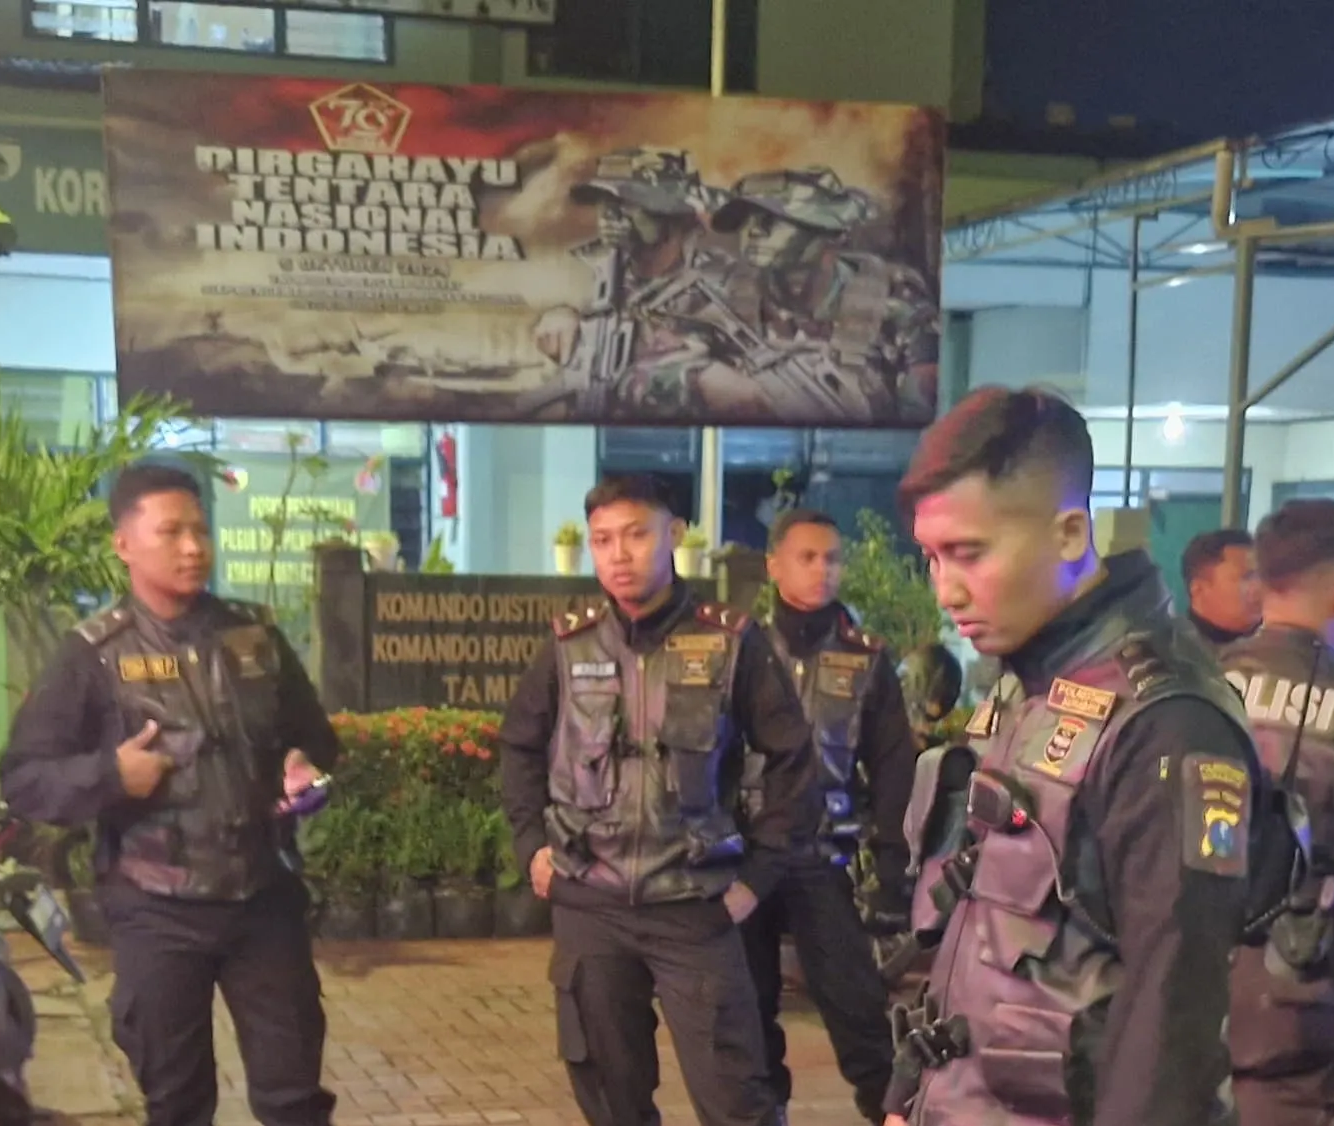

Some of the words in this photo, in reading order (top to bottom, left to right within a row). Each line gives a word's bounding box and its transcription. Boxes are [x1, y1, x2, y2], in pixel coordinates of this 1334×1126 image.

[195, 145, 519, 186] DIRGAHAYU
[228, 173, 475, 209] TENTARA
[231, 199, 480, 234] NASIONAL
[196, 223, 525, 259] INDONESIA
[377, 592, 484, 622] KOMANDO
[372, 633, 480, 663] KOMANDO
[484, 635, 543, 664] RAYO
